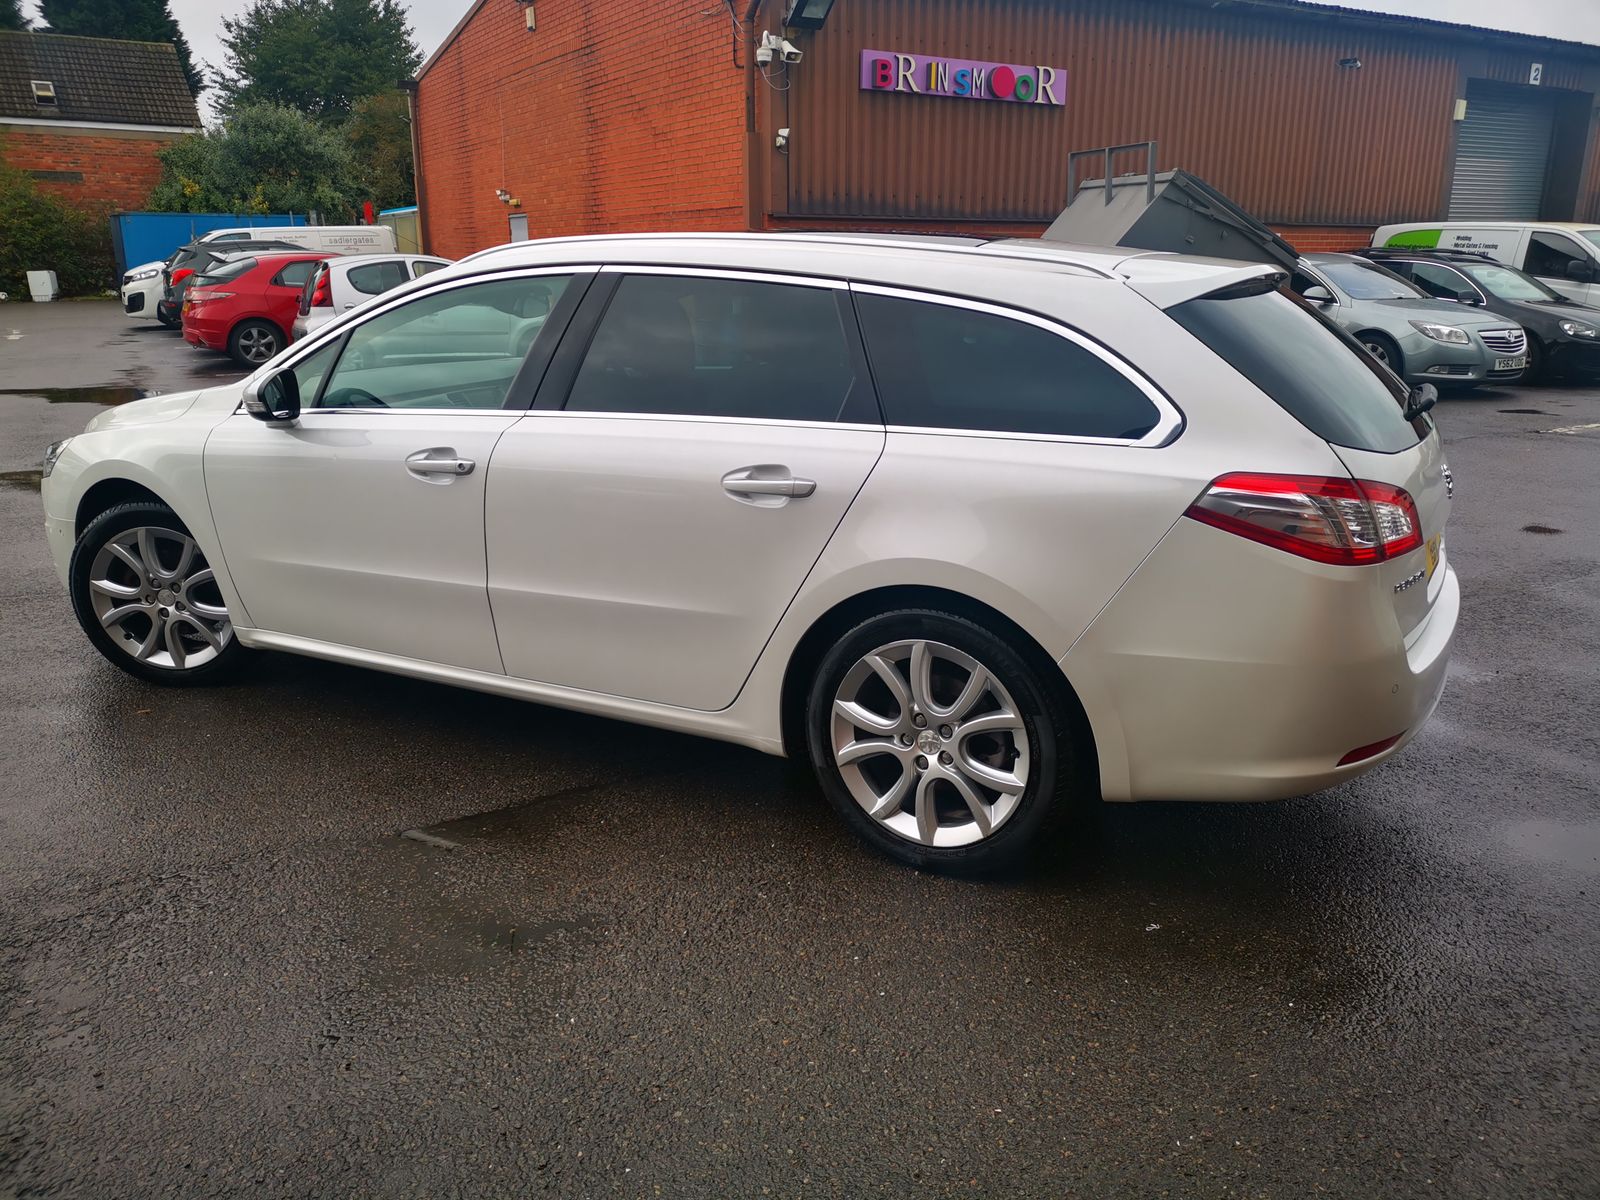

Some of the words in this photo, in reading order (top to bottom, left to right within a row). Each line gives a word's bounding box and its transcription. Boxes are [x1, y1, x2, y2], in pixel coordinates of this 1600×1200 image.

[872, 54, 1060, 105] BRINSMOOR
[1532, 67, 1540, 81] 2
[1498, 359, 1514, 368] YS62
